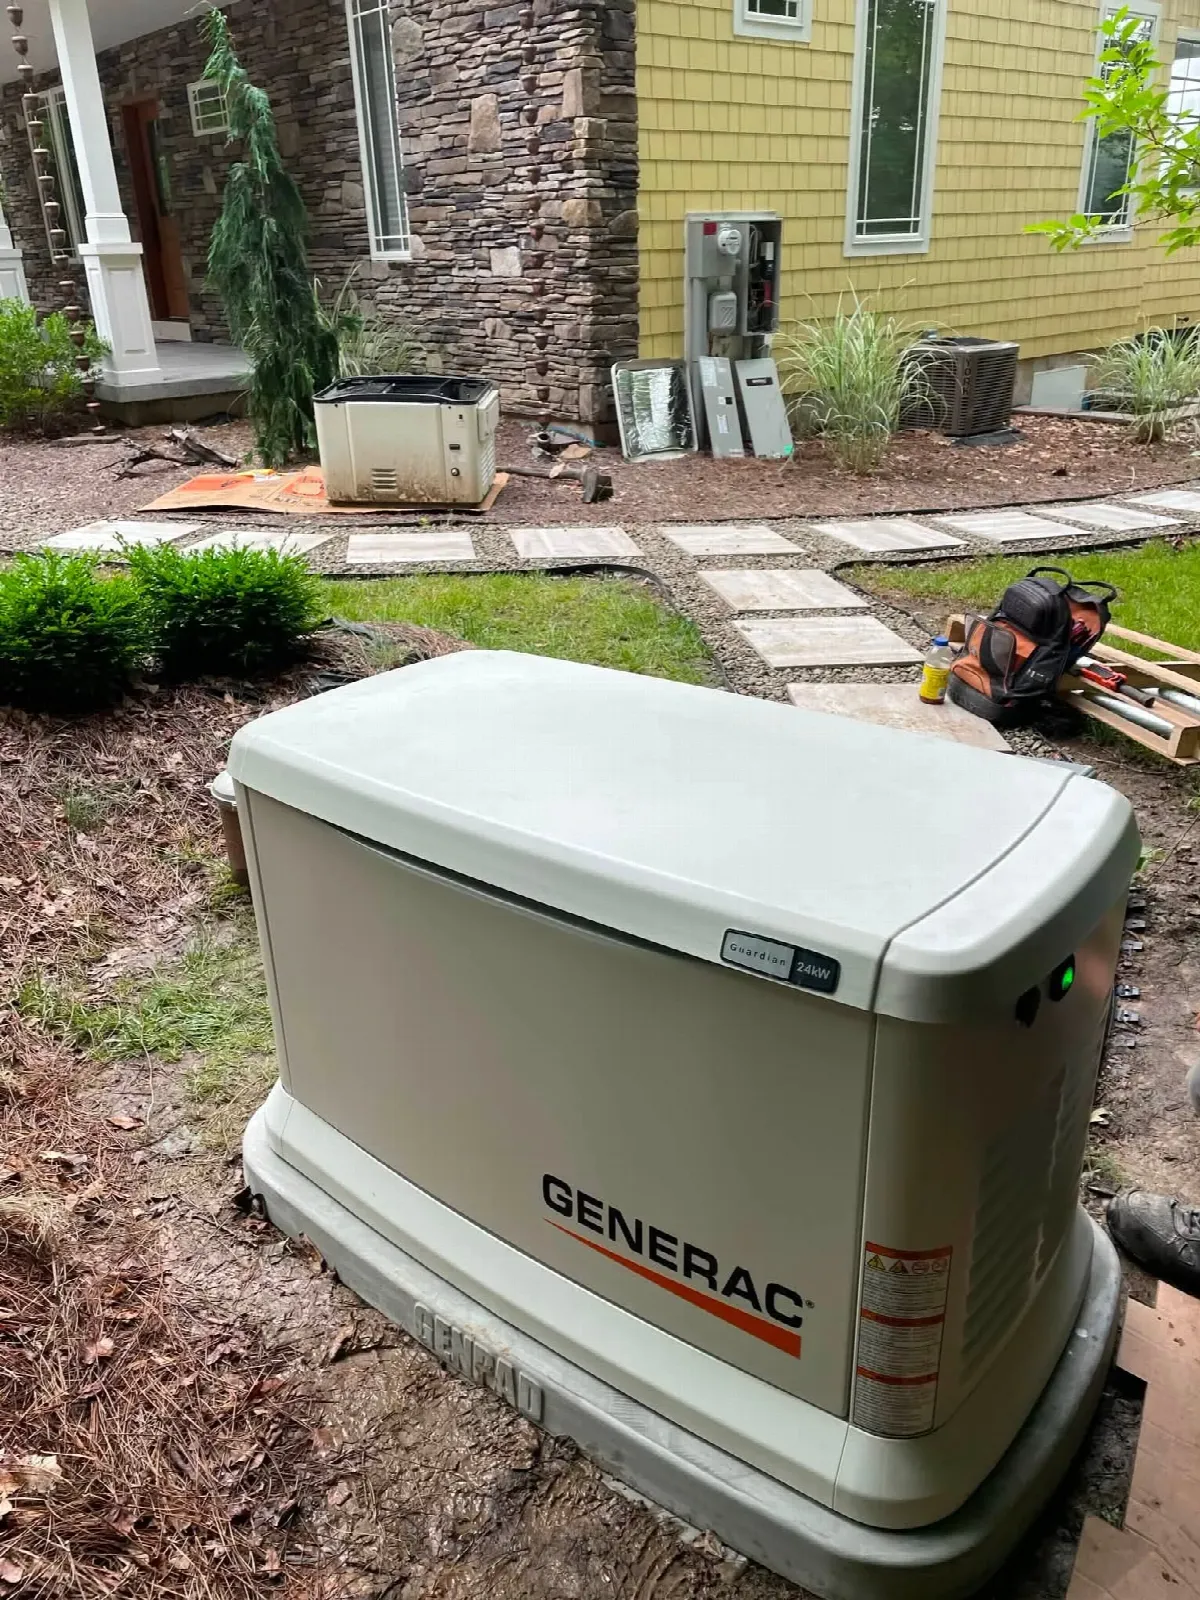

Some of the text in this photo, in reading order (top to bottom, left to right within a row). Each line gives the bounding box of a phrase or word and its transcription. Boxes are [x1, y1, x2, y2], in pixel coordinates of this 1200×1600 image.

[729, 943, 831, 980] Guardian 24kW
[542, 1174, 803, 1328] GENERAC
